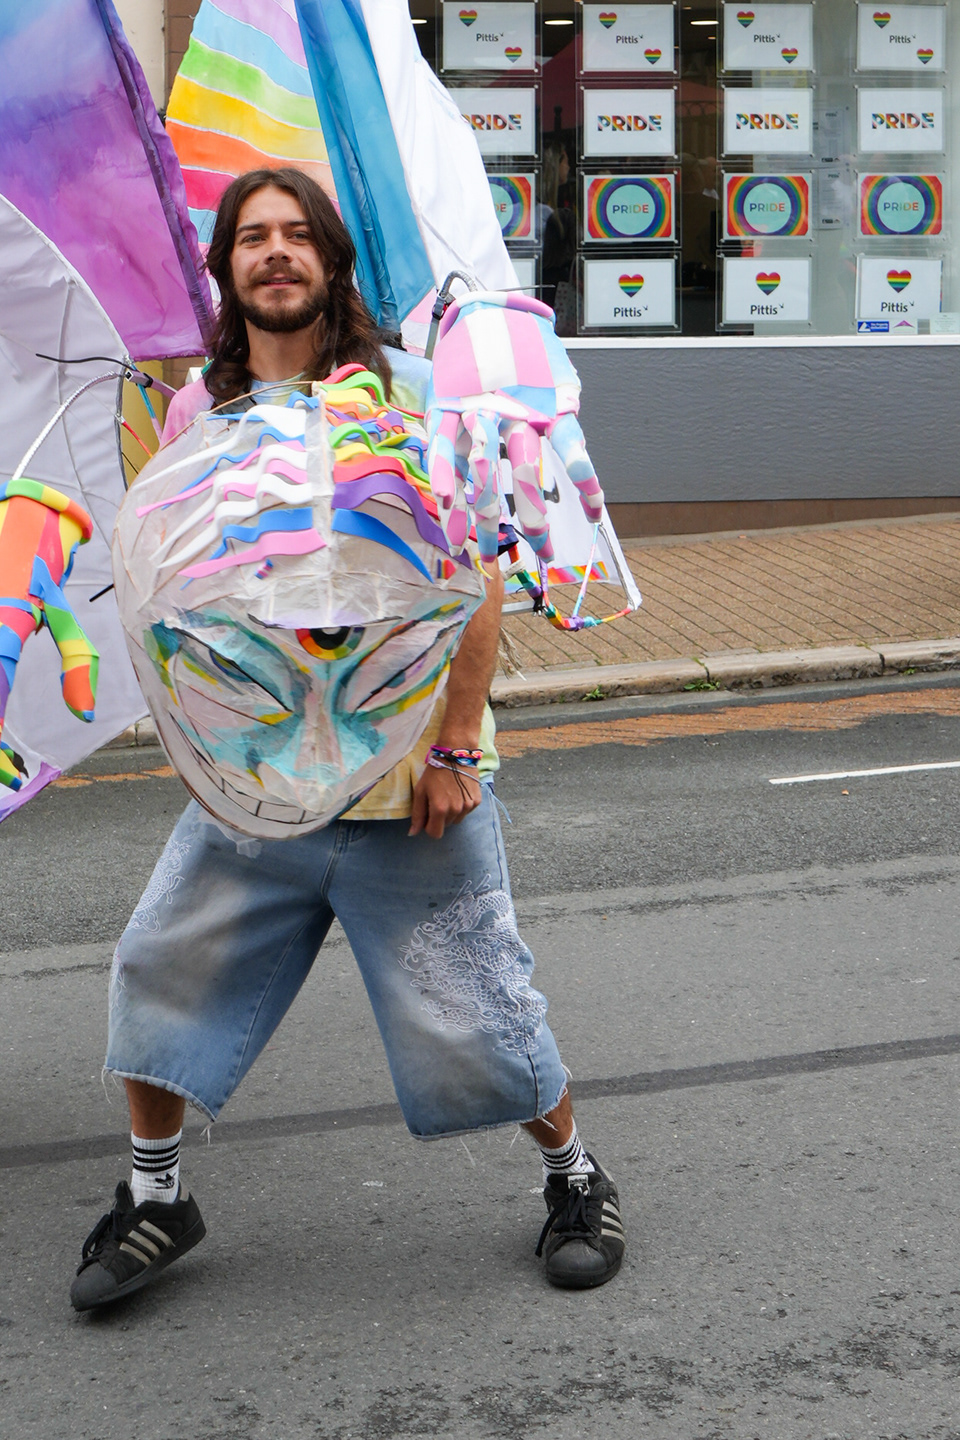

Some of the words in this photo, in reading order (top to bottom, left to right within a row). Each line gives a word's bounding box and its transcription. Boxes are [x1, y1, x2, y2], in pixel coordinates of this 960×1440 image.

[476, 32, 499, 42] Pittis
[616, 34, 638, 44] Pittis
[753, 33, 776, 43] Pittis
[889, 34, 911, 44] Pittis
[597, 115, 662, 131] PRIDE
[736, 113, 799, 130] PRIDE
[872, 112, 935, 129] PRIDE
[612, 204, 649, 214] PRIDE
[749, 203, 786, 212] PRIDE
[883, 202, 919, 211] PRIDE
[613, 307, 642, 317] Pittis
[750, 304, 778, 315] Pittis
[881, 302, 908, 312] Pittis
